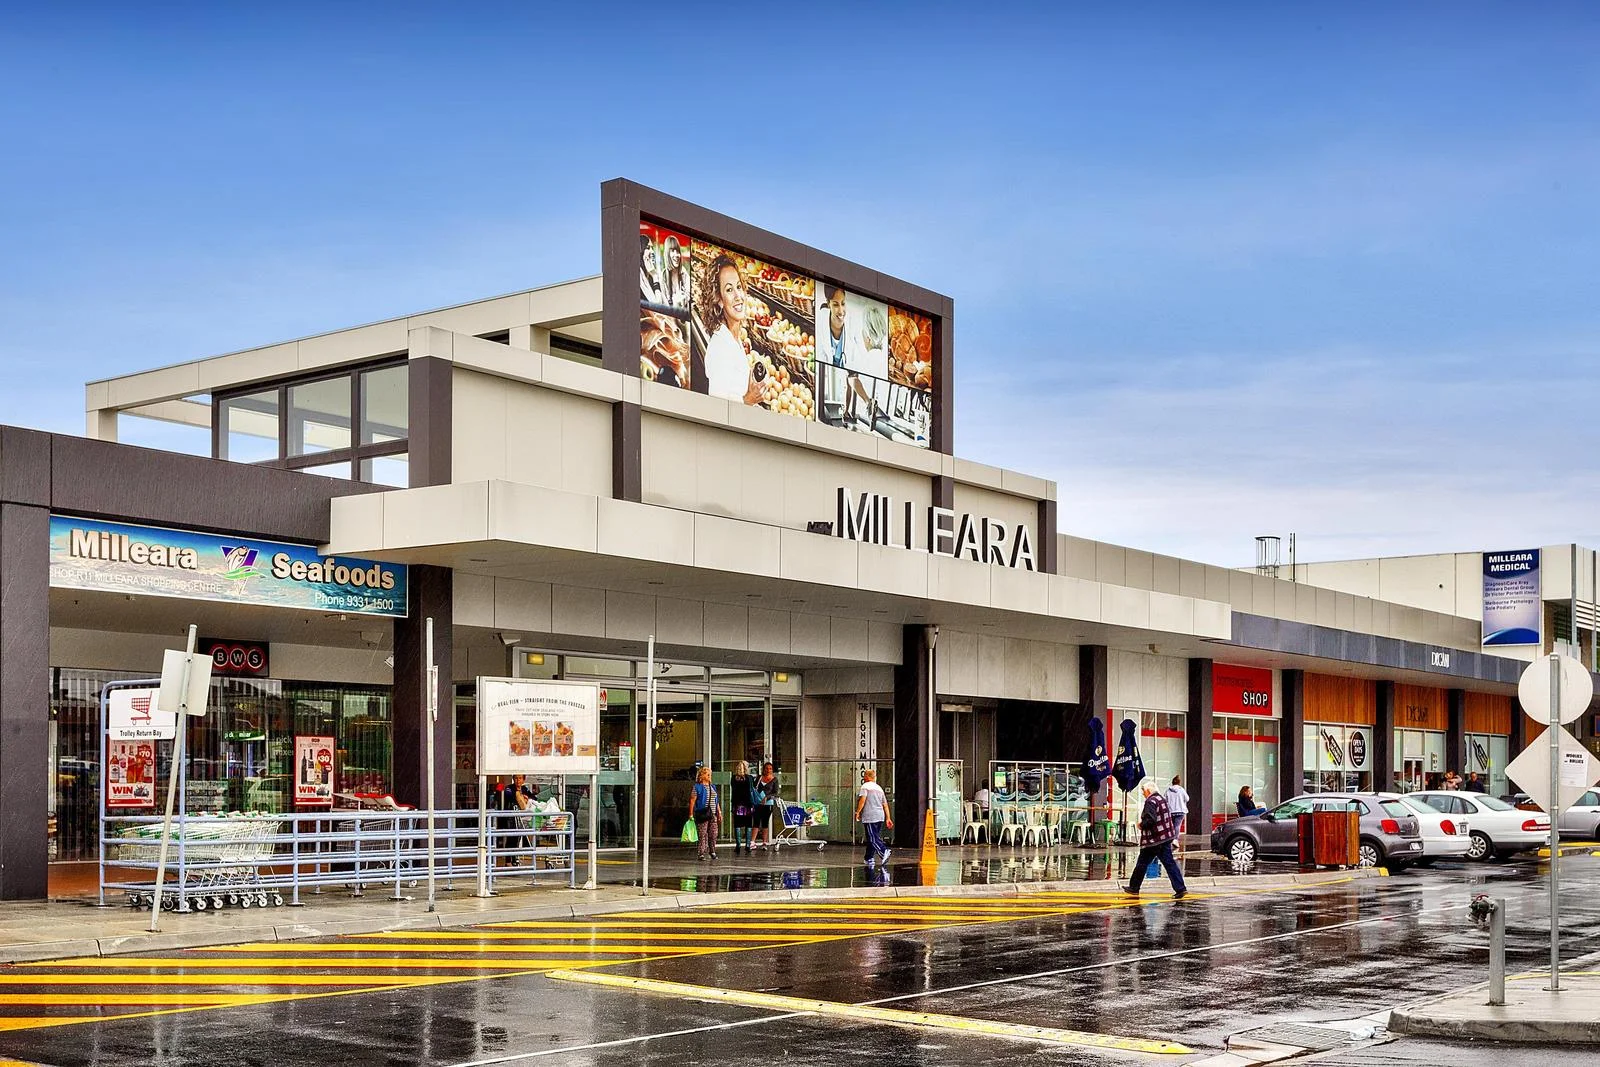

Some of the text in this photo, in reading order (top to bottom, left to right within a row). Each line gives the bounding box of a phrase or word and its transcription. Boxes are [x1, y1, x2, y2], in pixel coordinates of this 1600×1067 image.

[837, 487, 1038, 572] MILLEARA
[70, 528, 395, 590] Milleara Seafoods
[1488, 553, 1532, 563] MILLEARA
[1490, 563, 1531, 572] MEDICAL
[315, 592, 394, 610] Phone 9331 1500
[217, 652, 259, 664] BWS
[1243, 691, 1268, 706] SHOP
[120, 730, 135, 738] Trolley
[153, 729, 162, 738] Bay
[112, 786, 133, 795] WIN
[298, 786, 316, 794] WIN
